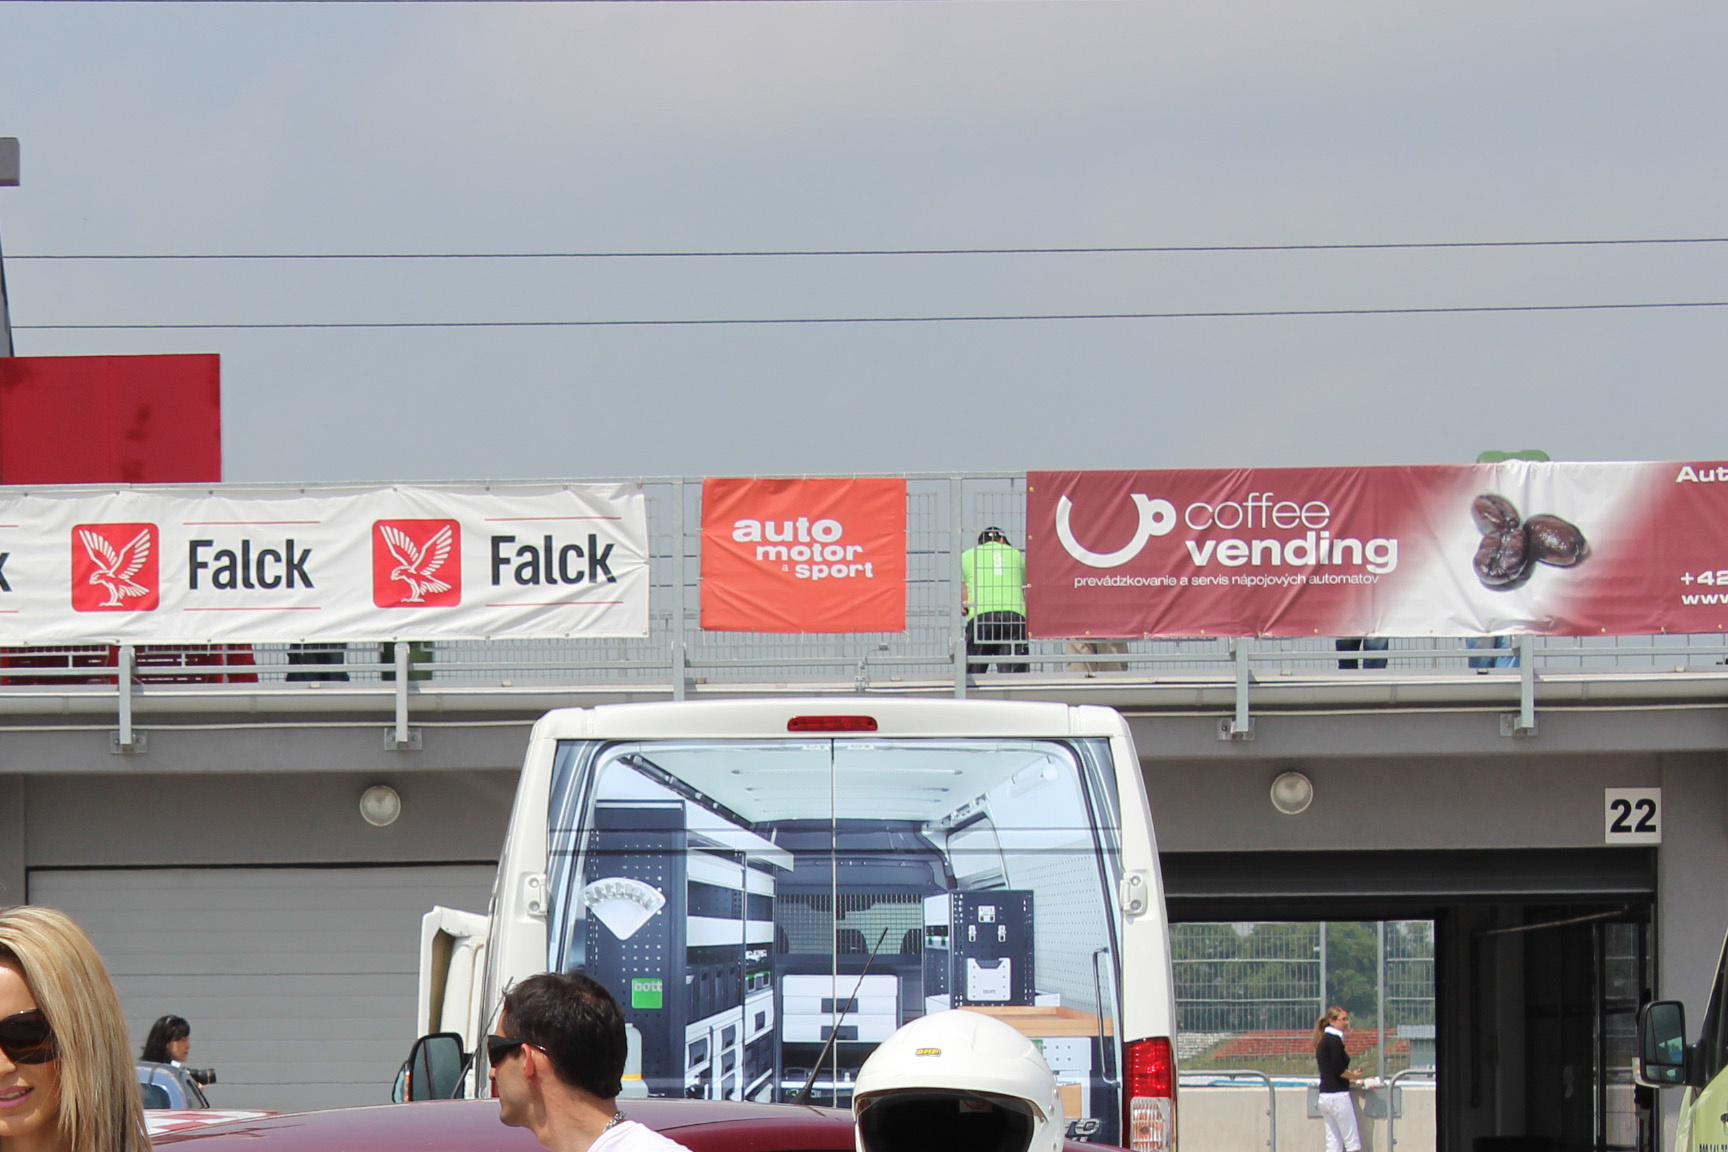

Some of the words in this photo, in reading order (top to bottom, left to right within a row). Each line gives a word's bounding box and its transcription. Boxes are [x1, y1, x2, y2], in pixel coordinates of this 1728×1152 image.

[1185, 492, 1330, 530] coffee
[732, 516, 844, 544] auto
[188, 538, 314, 590] Falck
[490, 533, 618, 586] Falck
[756, 543, 864, 562] motor
[1185, 531, 1398, 574] vending
[794, 561, 874, 581] sport
[1074, 573, 1177, 588] prevádzkovanie
[1179, 576, 1189, 586] a
[1191, 574, 1227, 586] servis
[1231, 572, 1306, 587] nápojových
[1309, 573, 1380, 585] automatov
[1610, 798, 1657, 833] 22
